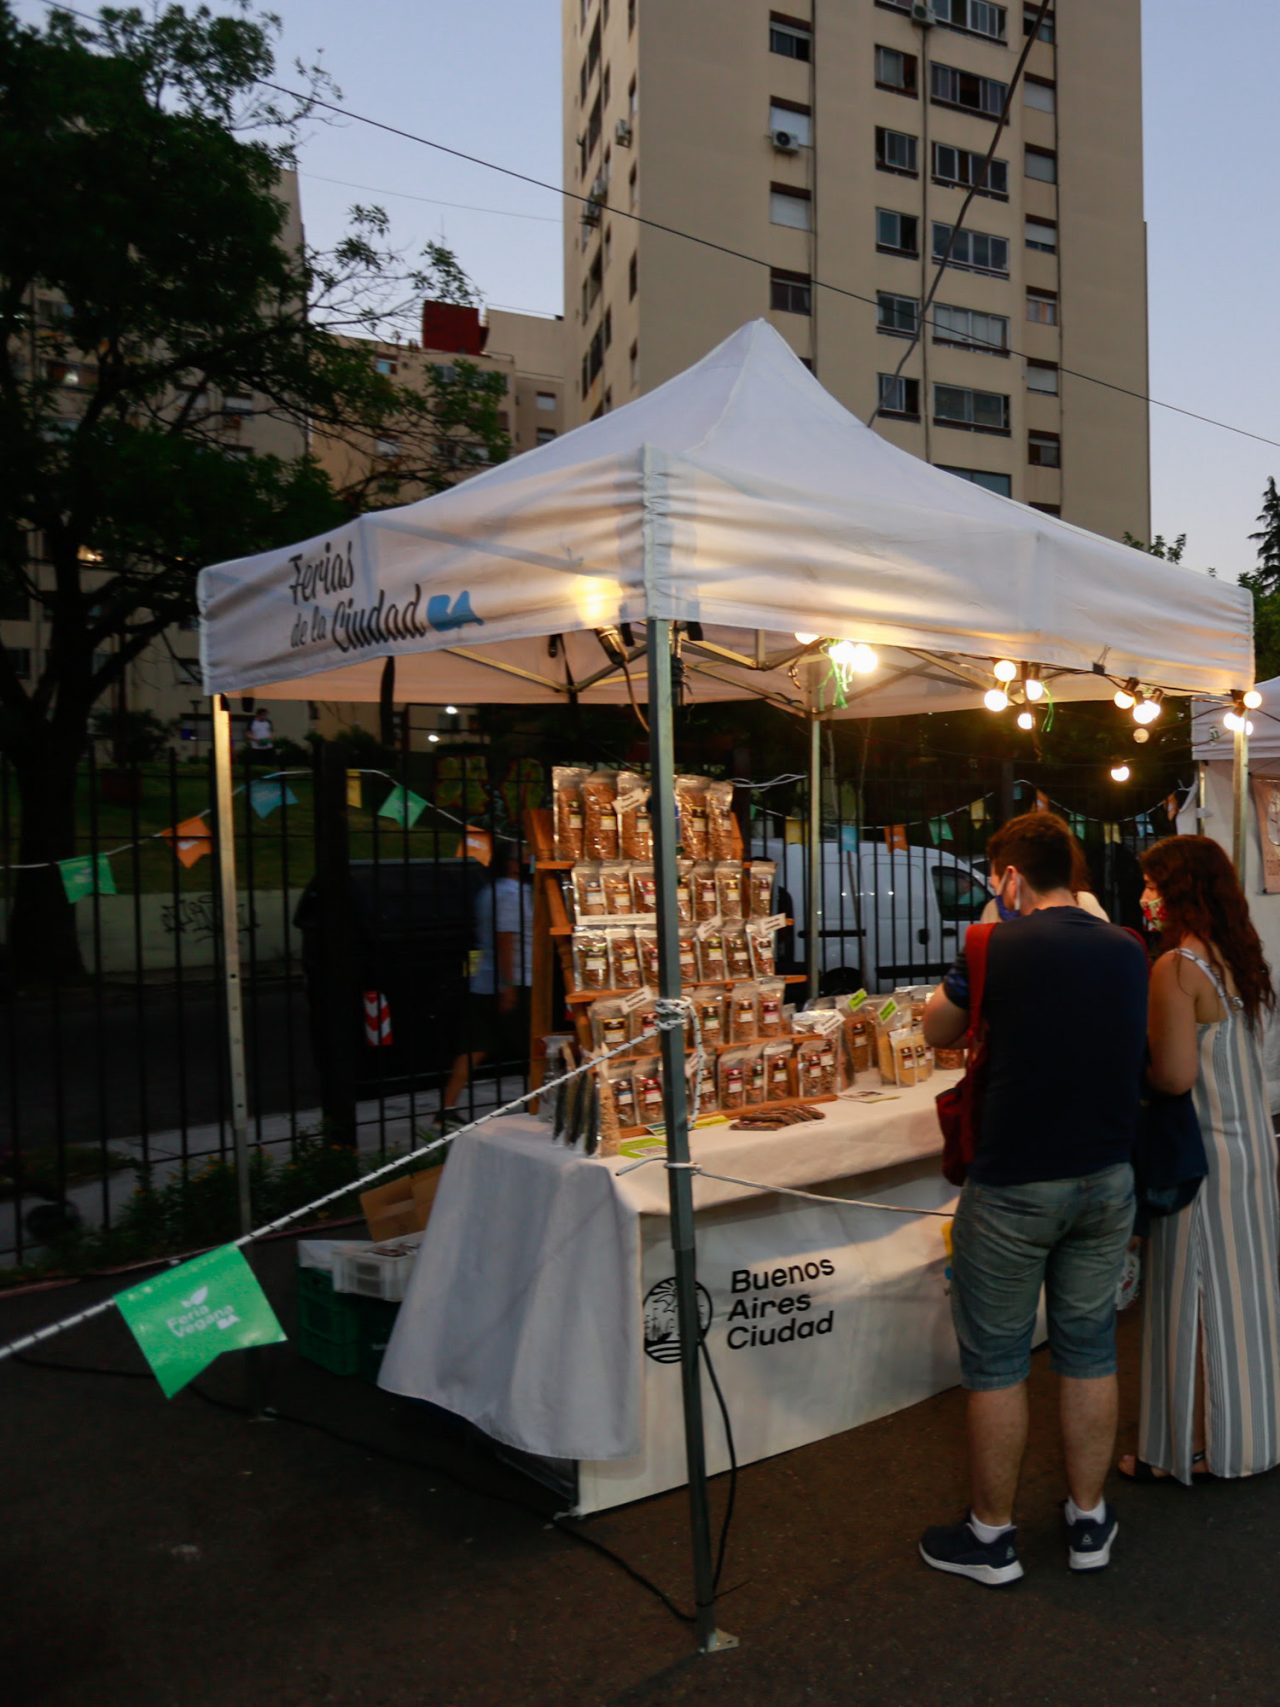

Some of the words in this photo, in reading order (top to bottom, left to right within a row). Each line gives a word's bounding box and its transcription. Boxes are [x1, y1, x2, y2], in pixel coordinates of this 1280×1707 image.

[289, 541, 354, 604] Ferias
[290, 613, 308, 648] de
[311, 606, 327, 642] la
[332, 584, 426, 652] Ciudad
[731, 1259, 835, 1294] Buenos
[168, 1305, 209, 1329] Feria
[169, 1305, 234, 1337] Vegana
[727, 1293, 811, 1321] Aires
[727, 1311, 834, 1350] Ciudad
